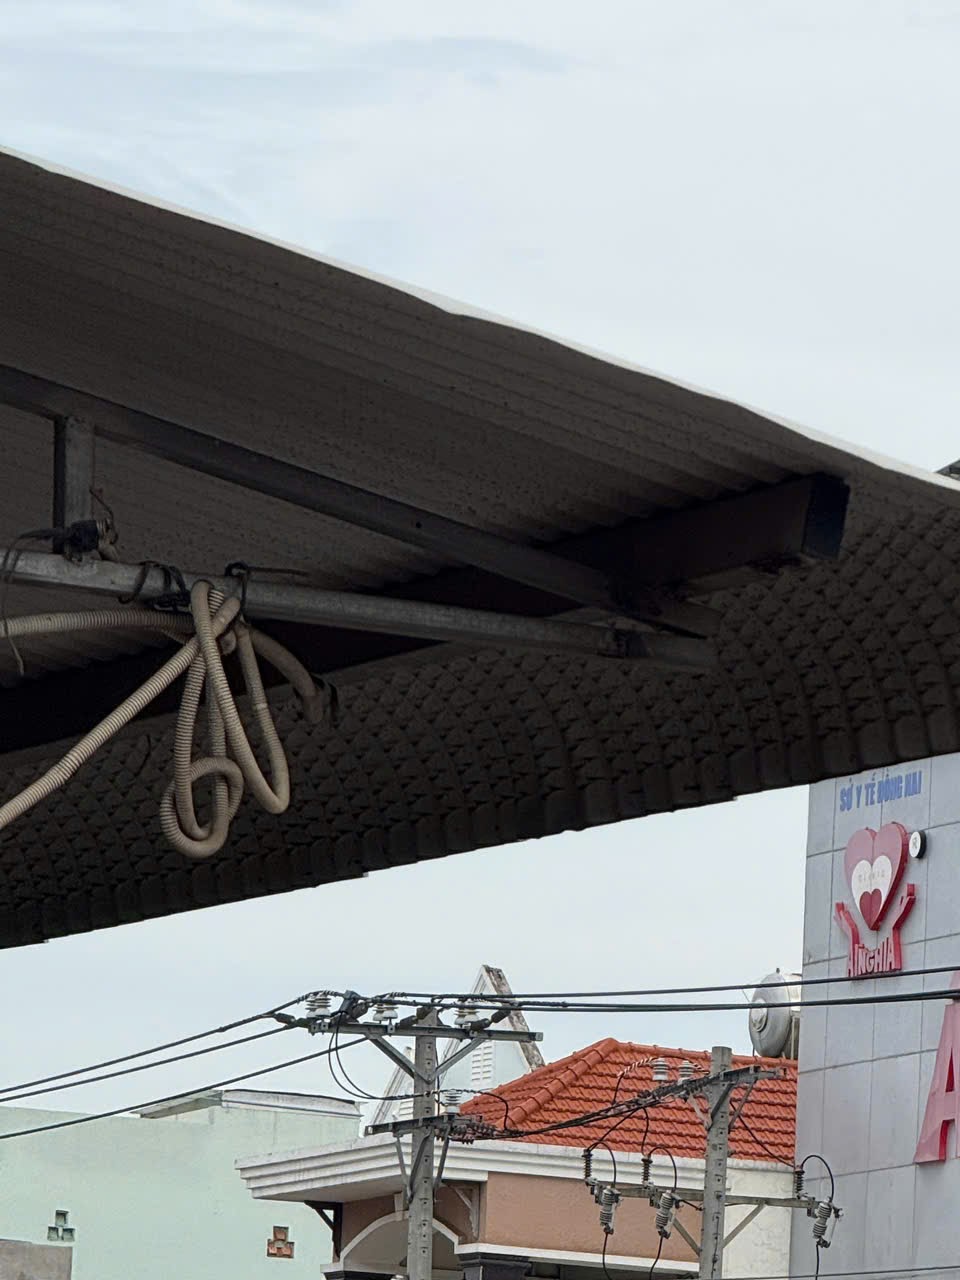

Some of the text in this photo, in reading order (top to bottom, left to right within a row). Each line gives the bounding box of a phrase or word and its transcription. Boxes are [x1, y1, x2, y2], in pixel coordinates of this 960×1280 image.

[855, 783, 862, 809] Y
[865, 771, 876, 807] TẾ
[904, 770, 922, 798] NAI
